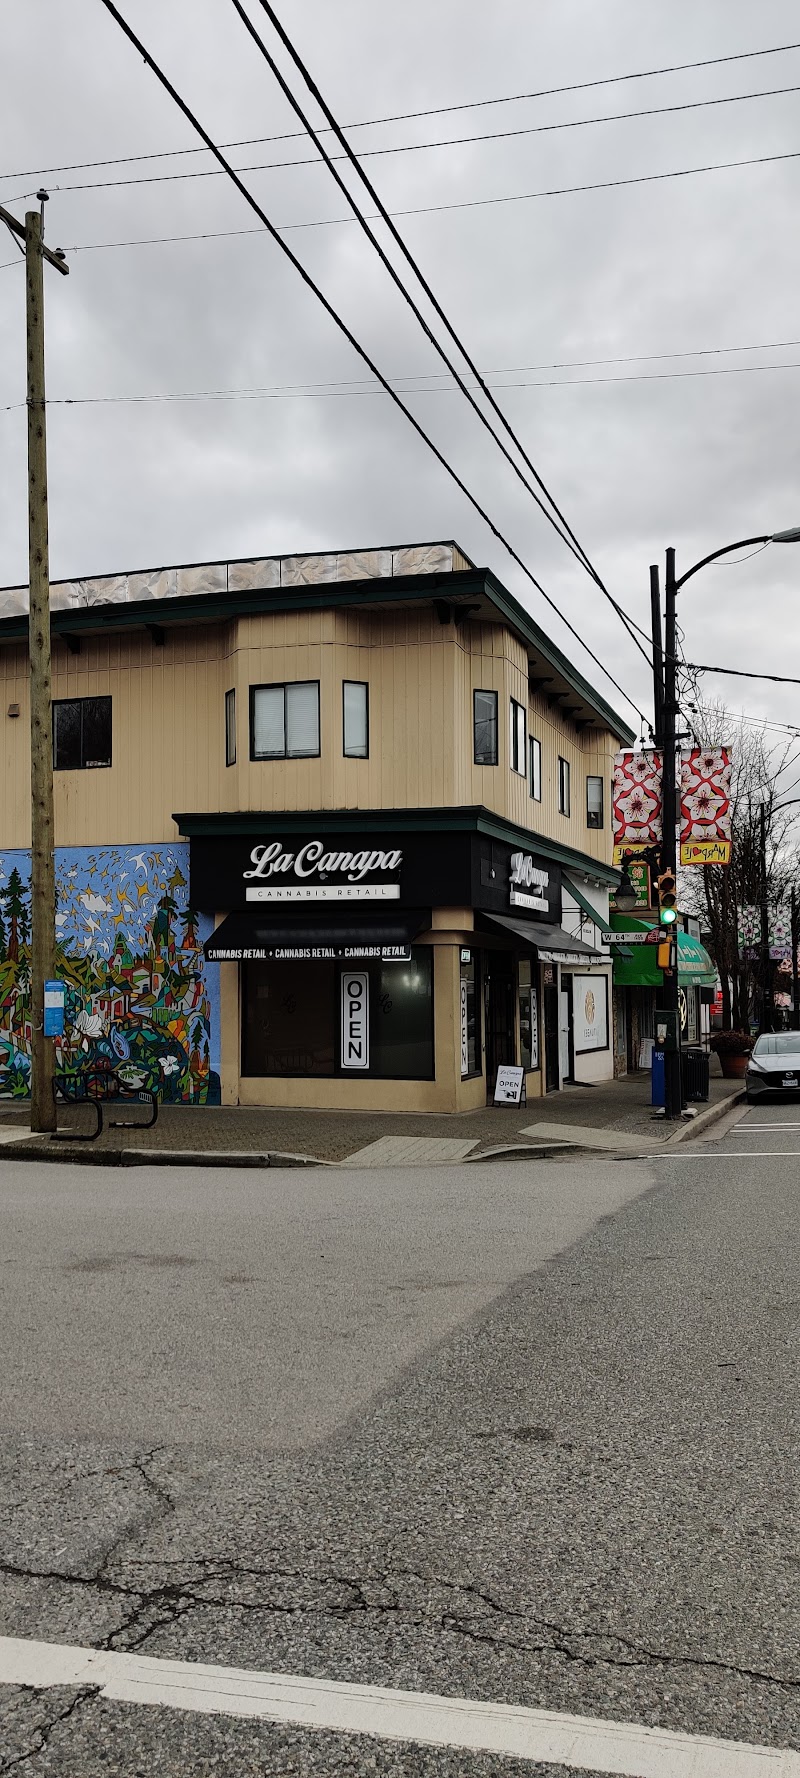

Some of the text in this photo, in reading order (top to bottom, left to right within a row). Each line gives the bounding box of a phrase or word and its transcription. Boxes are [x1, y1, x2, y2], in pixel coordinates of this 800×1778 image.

[243, 840, 403, 881] La Canapa
[337, 888, 387, 896] RETAIL
[208, 945, 406, 959] CANNABIS RETAIL CANNABIS RETAIL CANNABIS RETAIL
[347, 980, 363, 1059] OPEN
[499, 1080, 519, 1088] OPEN
